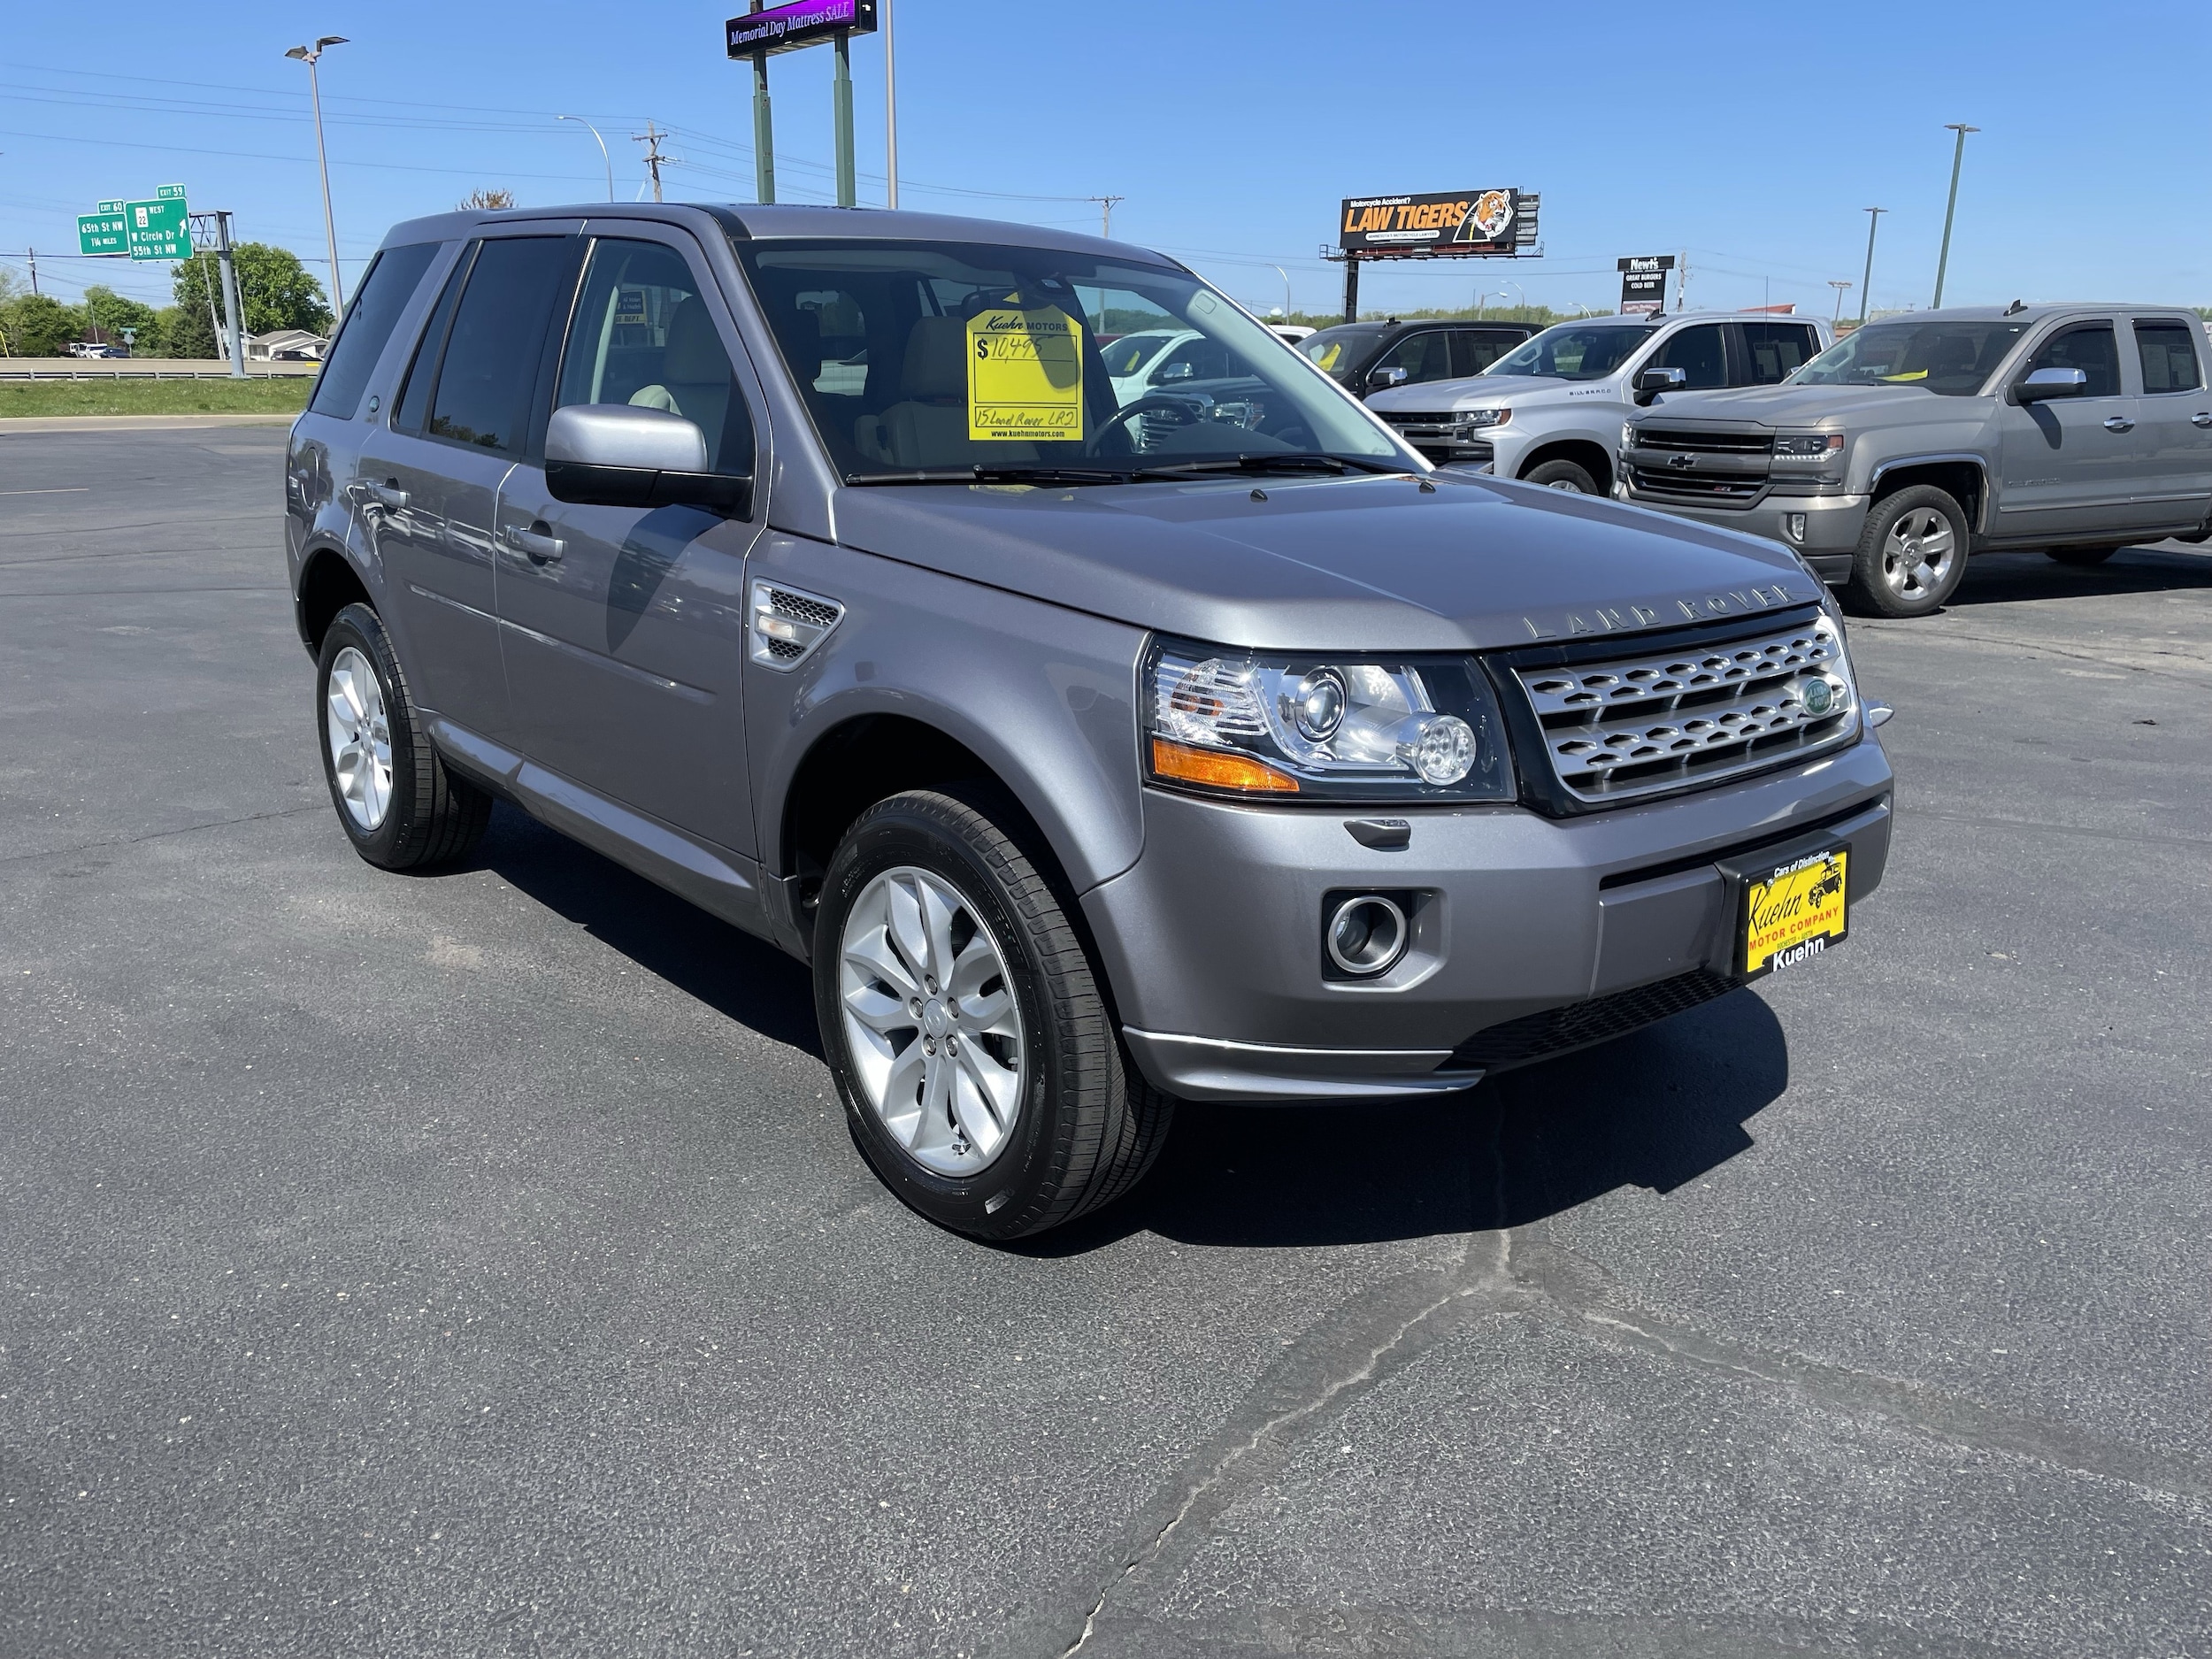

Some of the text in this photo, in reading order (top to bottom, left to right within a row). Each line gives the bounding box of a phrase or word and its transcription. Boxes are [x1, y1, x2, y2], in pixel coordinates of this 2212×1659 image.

[730, 1, 849, 45] Memorial Day Mattress SALE
[173, 187, 183, 196] 59
[112, 202, 122, 211] 60
[149, 205, 165, 214] WEST
[1350, 196, 1411, 208] Motorcycle Accident?
[138, 216, 147, 225] 22
[1344, 201, 1468, 233] LAW TIGERS
[81, 221, 123, 234] 65th St NW
[131, 230, 174, 242] W Circle Dr
[133, 243, 176, 256] 55th St NW
[1631, 257, 1659, 270] Newt's
[986, 315, 1068, 331] Kuehn MOTORS
[977, 338, 988, 360] $
[1048, 411, 1074, 426] LR2
[1523, 585, 1797, 638] LAND ROVER
[1774, 850, 1830, 878] Cars of Distinction
[1747, 875, 1802, 937] Kuehn
[1749, 906, 1839, 951] MOTOR COMPANY
[1777, 929, 1813, 949] ROCHESTER AUSTIN
[1773, 937, 1824, 972] Kuehn
